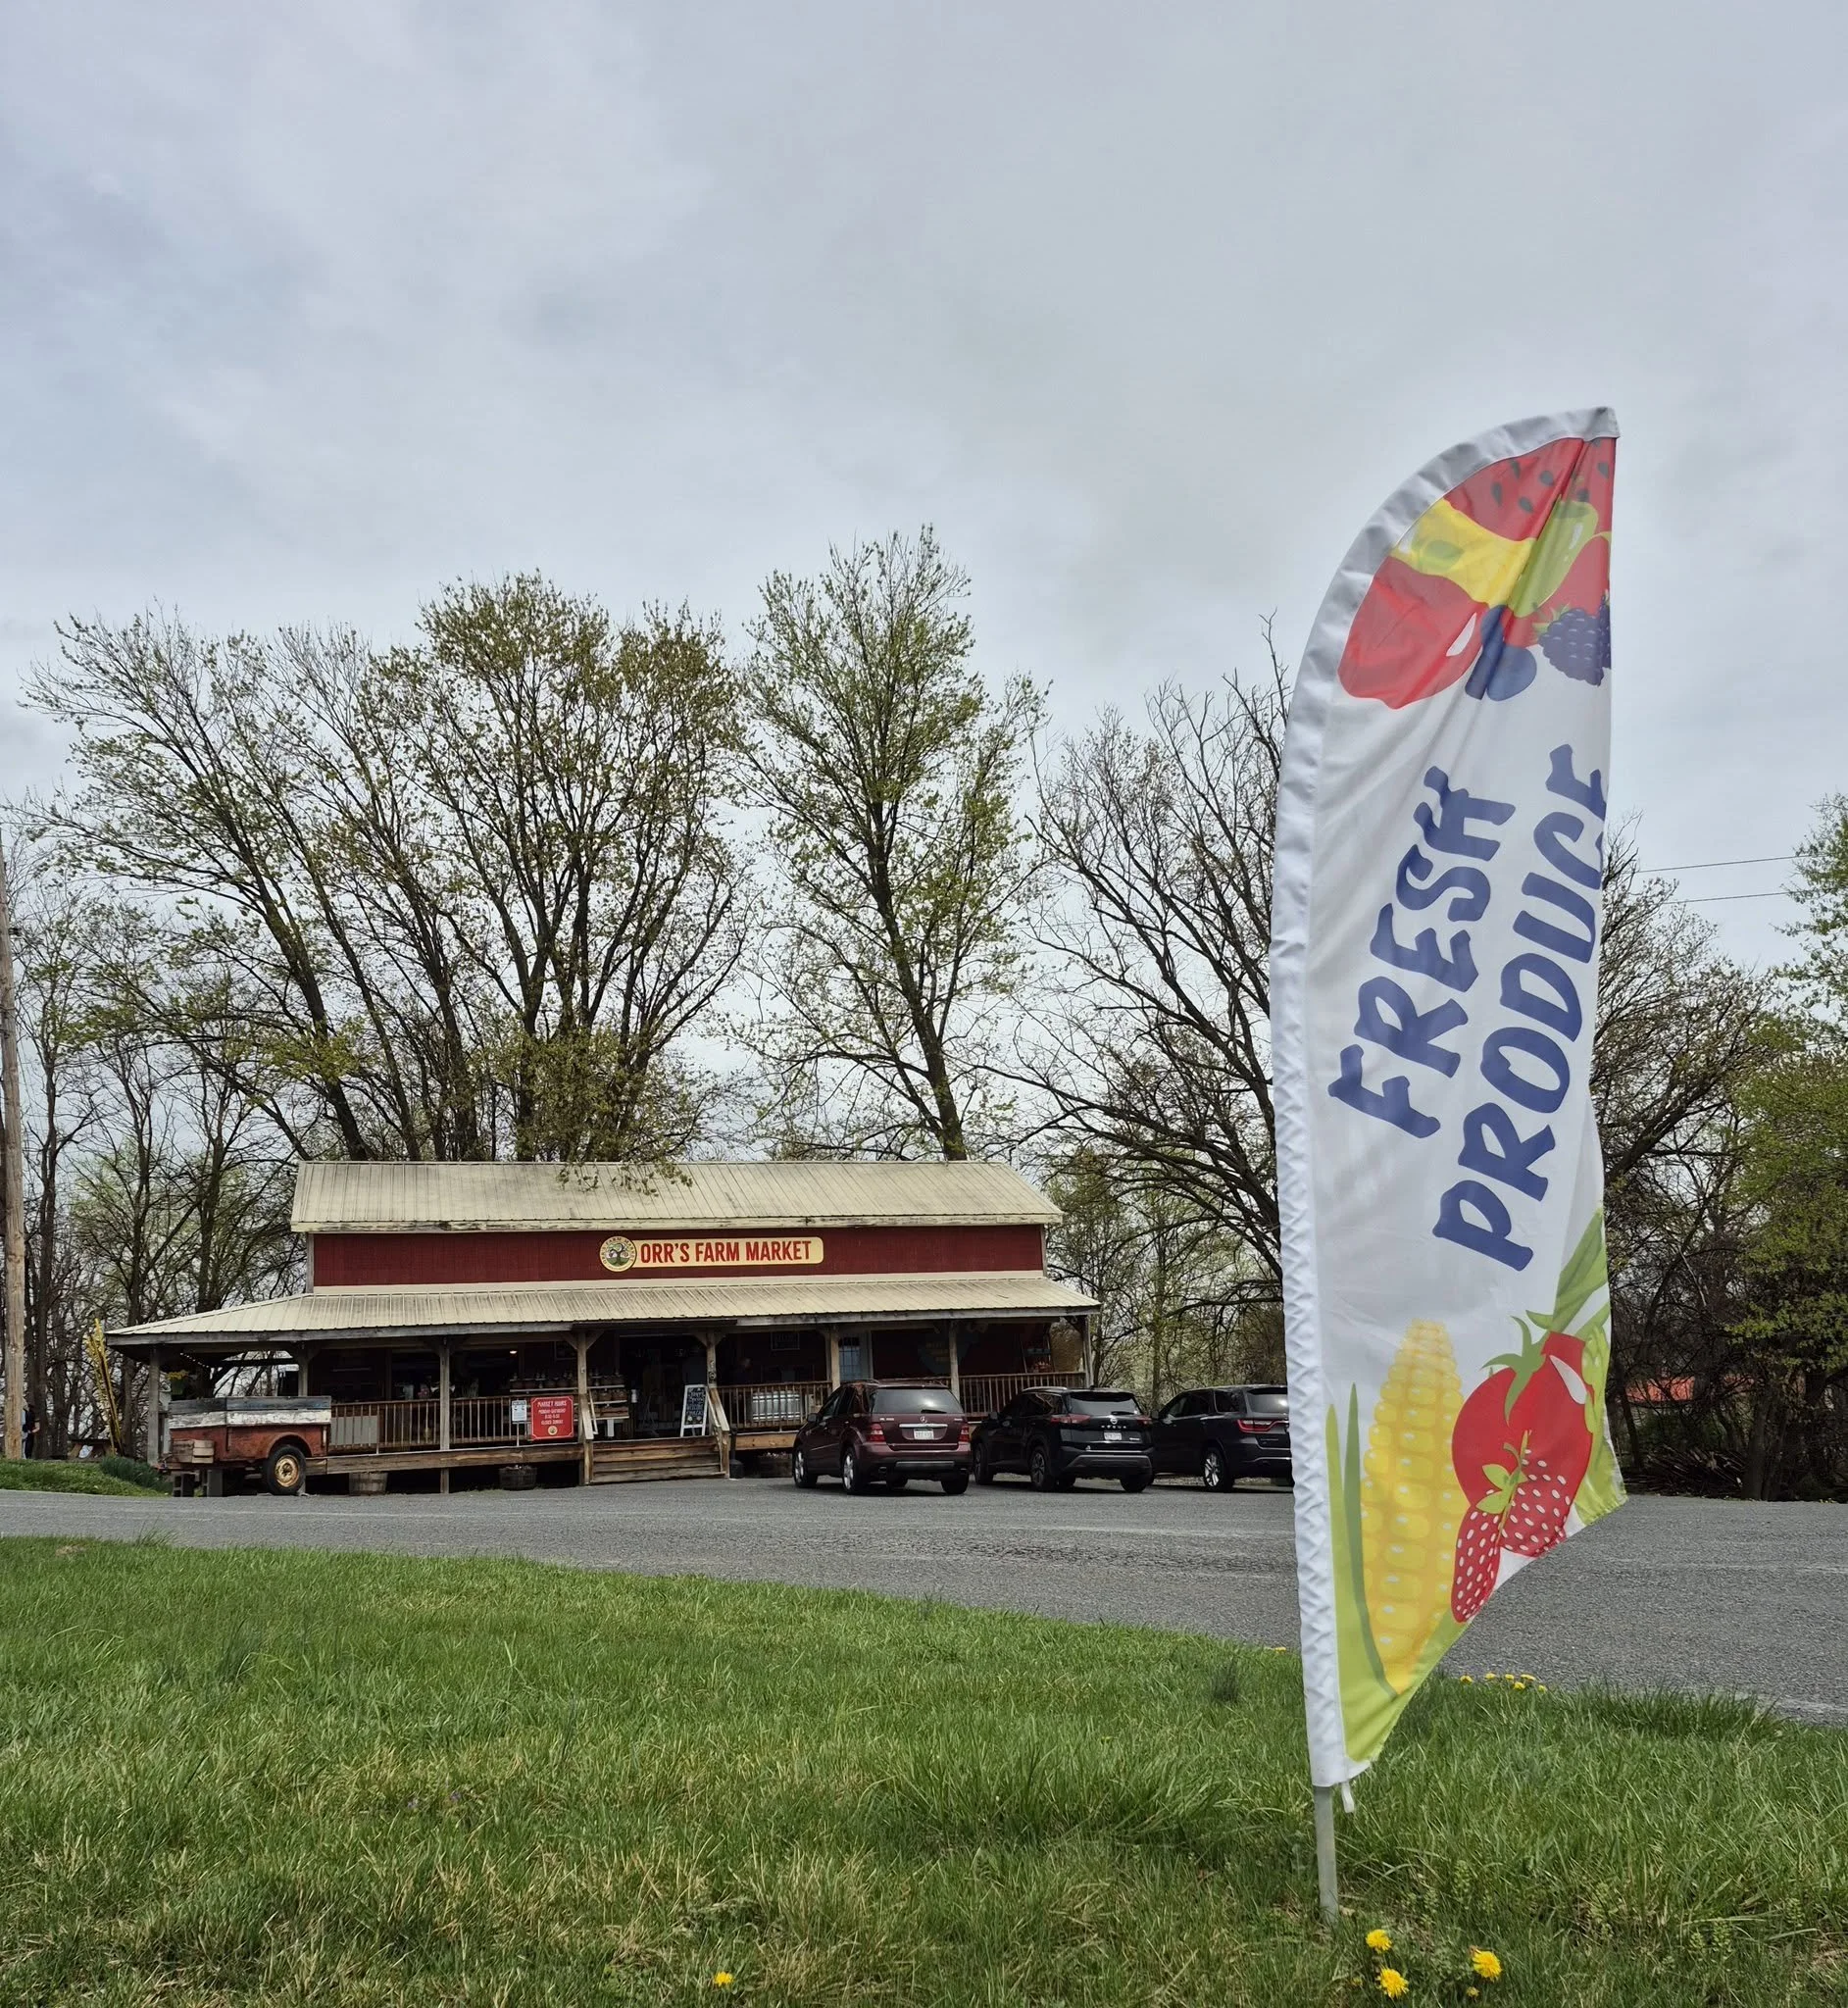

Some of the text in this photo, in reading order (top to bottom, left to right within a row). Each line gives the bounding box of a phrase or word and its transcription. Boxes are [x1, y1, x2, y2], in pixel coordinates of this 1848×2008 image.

[1327, 765, 1517, 1139] FRESH
[640, 1240, 812, 1264] ORR'S FARM MARKET
